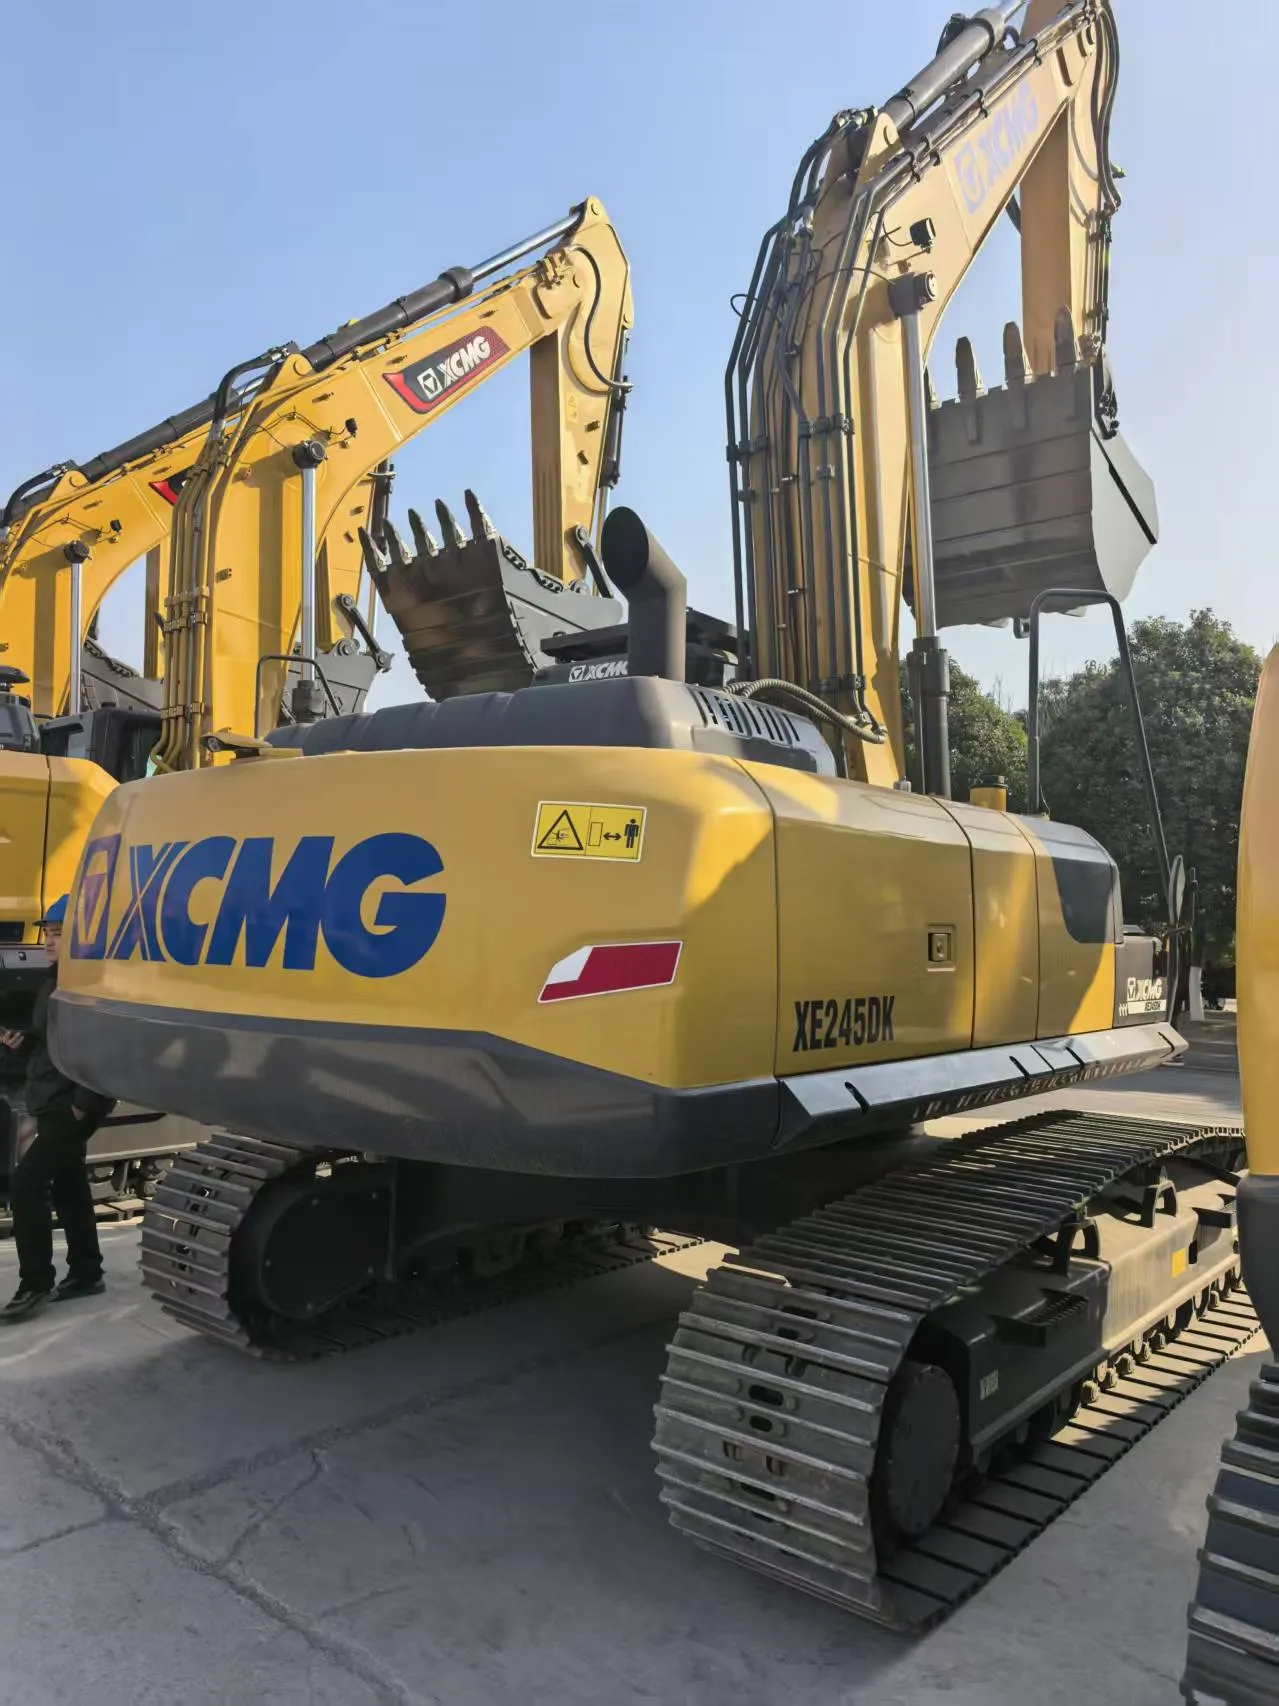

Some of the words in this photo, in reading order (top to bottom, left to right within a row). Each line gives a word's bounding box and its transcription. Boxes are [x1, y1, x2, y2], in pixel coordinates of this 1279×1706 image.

[437, 336, 490, 389] XCMG
[105, 832, 447, 978] XCMG
[793, 995, 895, 1052] XE245DK
